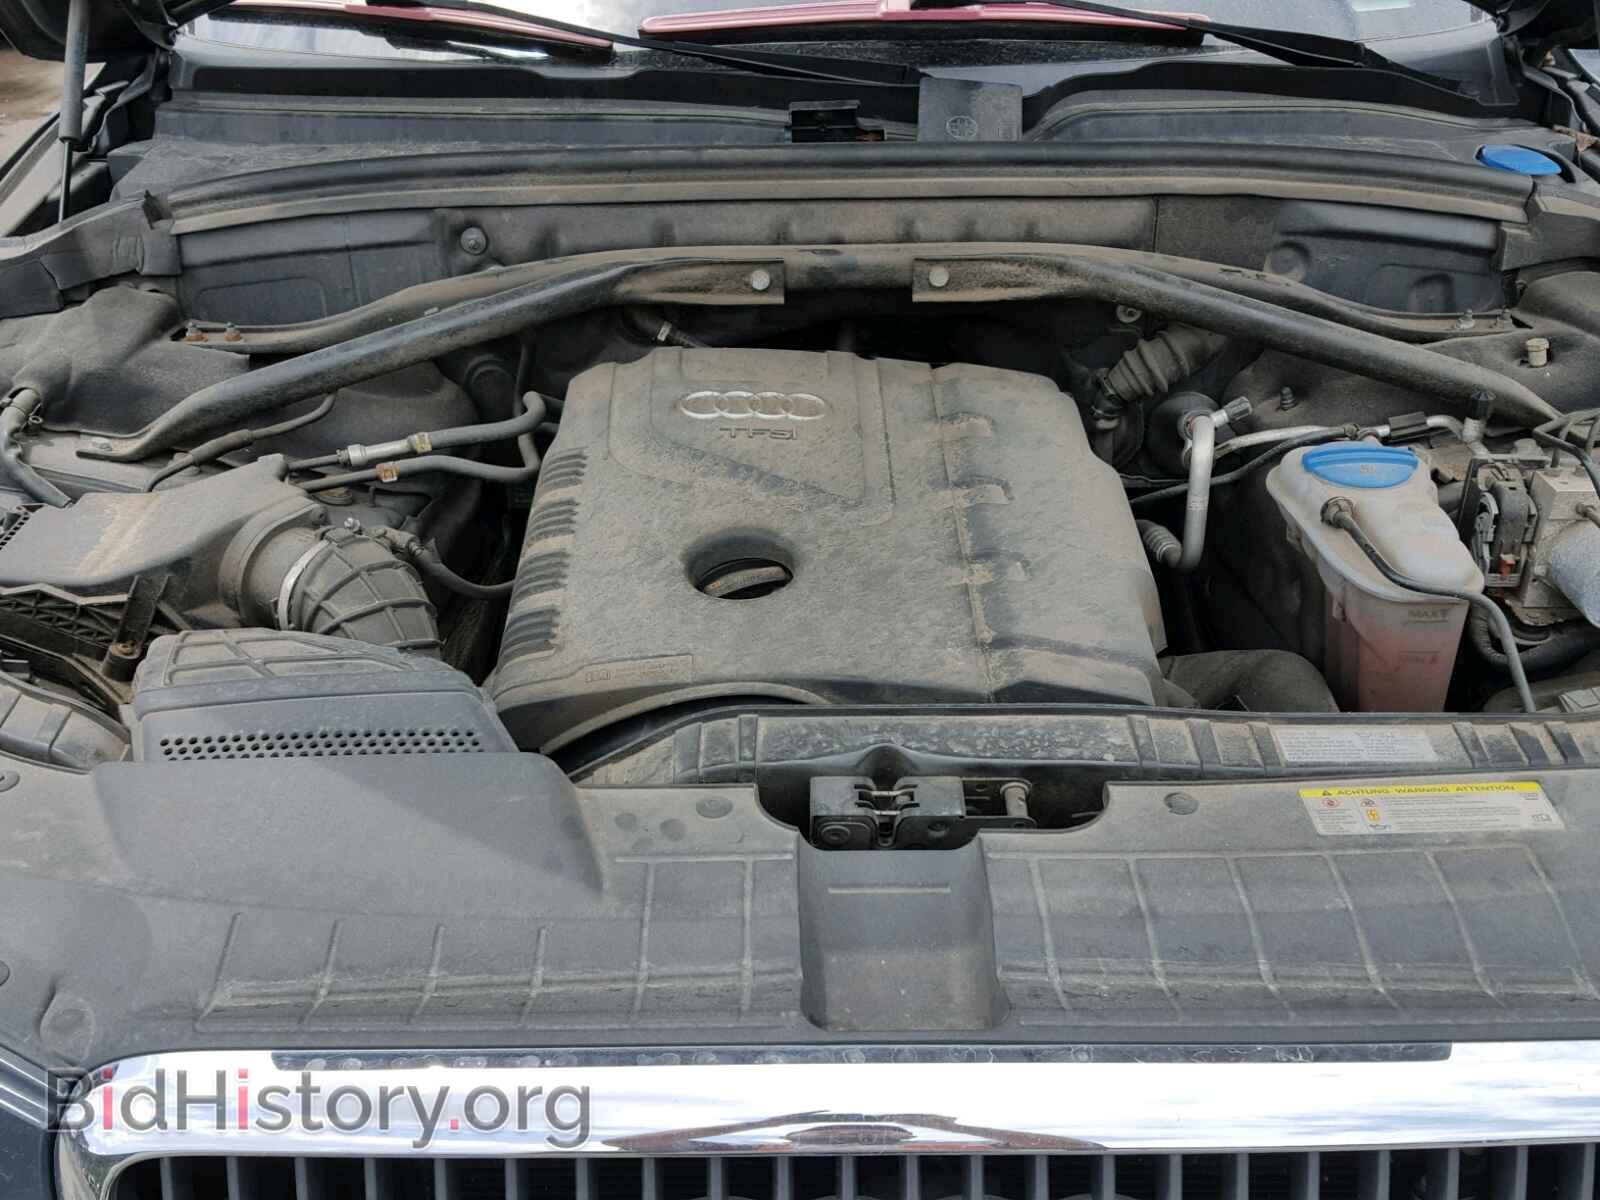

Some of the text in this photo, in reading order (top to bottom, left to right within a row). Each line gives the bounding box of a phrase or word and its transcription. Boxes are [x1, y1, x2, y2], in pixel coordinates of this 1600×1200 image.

[719, 427, 797, 440] TFSI
[1337, 784, 1516, 796] ACHTUNG WARNING ATTENTION
